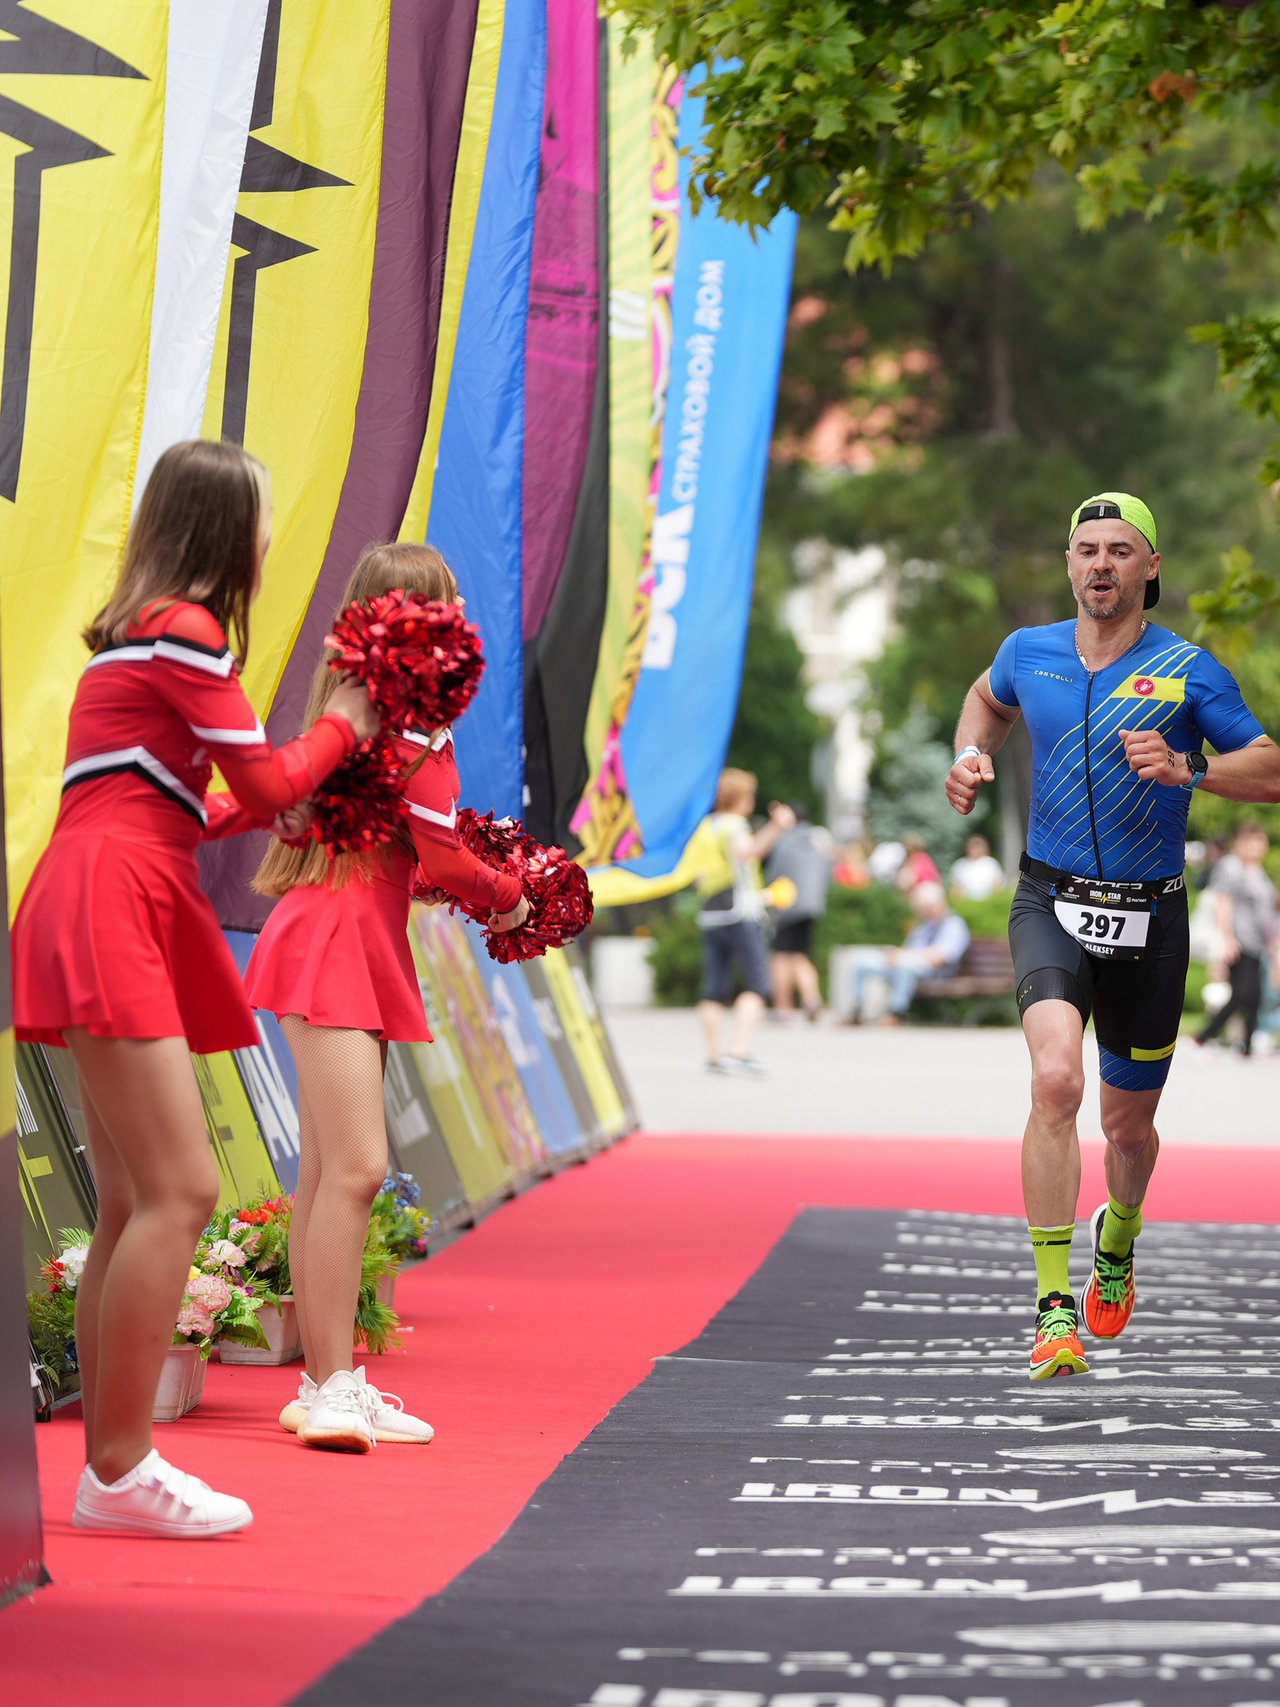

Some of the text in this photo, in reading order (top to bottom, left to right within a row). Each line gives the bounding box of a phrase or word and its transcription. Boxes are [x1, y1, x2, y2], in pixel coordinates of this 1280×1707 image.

[671, 260, 725, 503] СТРАХОВОЙ ДОМ
[1089, 889, 1103, 898] IRON
[1107, 892, 1121, 900] STAR
[1078, 911, 1126, 940] 297
[1085, 943, 1114, 955] ALEKSEY
[780, 1414, 1042, 1426] IRON
[740, 1482, 1039, 1502] IRON
[680, 1575, 1029, 1593] IRON
